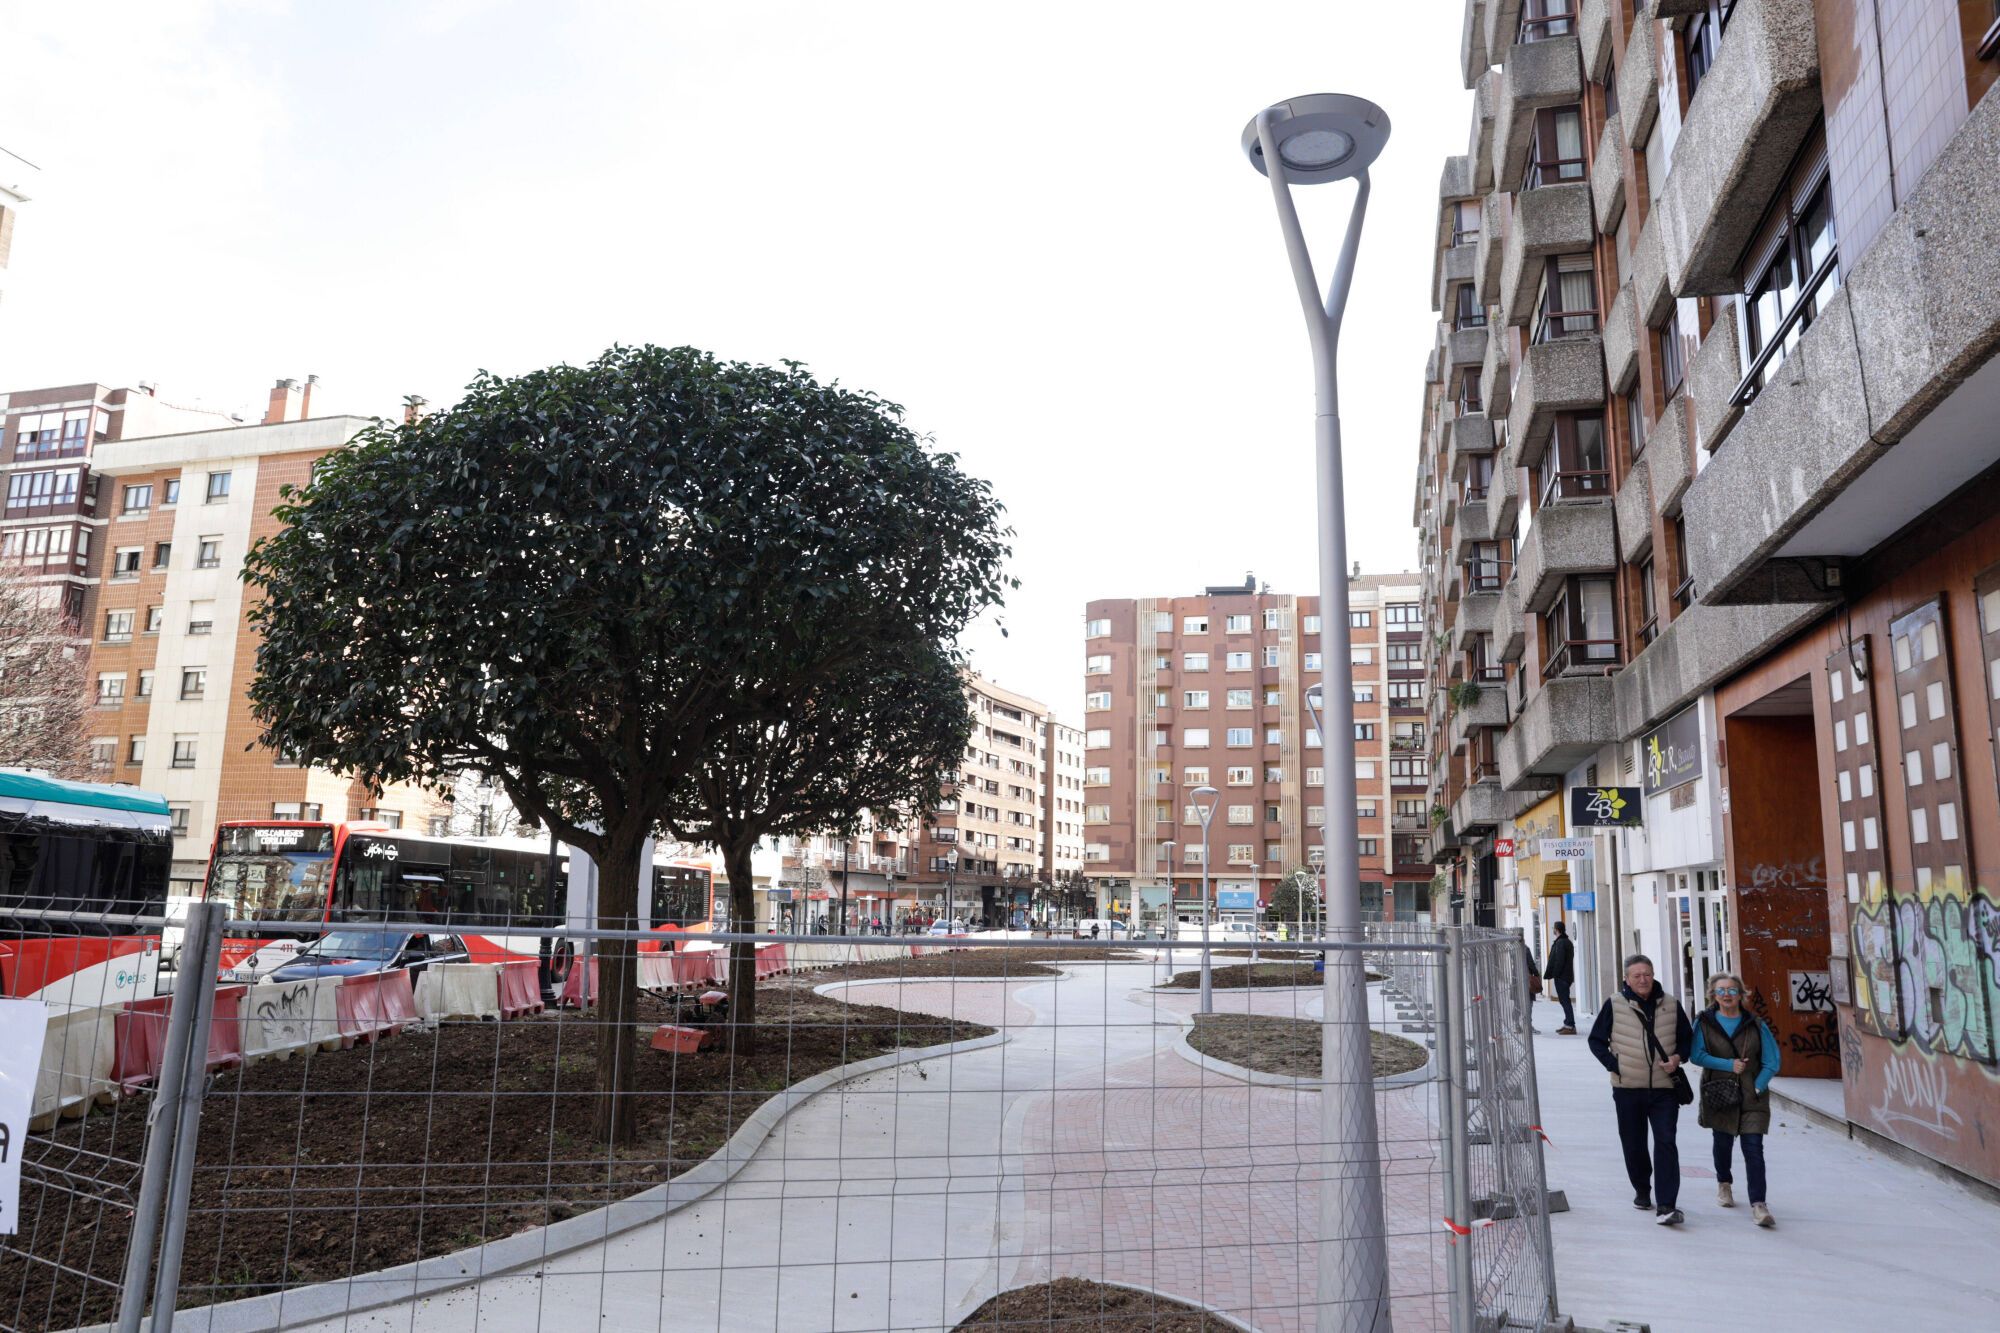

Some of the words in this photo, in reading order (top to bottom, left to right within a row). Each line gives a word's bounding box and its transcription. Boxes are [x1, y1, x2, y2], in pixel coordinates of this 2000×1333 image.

[1585, 792, 1613, 819] ZB
[153, 824, 167, 836] 417
[231, 830, 237, 844] 1
[1496, 842, 1512, 855] illy
[1555, 849, 1585, 857] PRADO
[280, 944, 293, 952] 411
[127, 972, 147, 984] ebus
